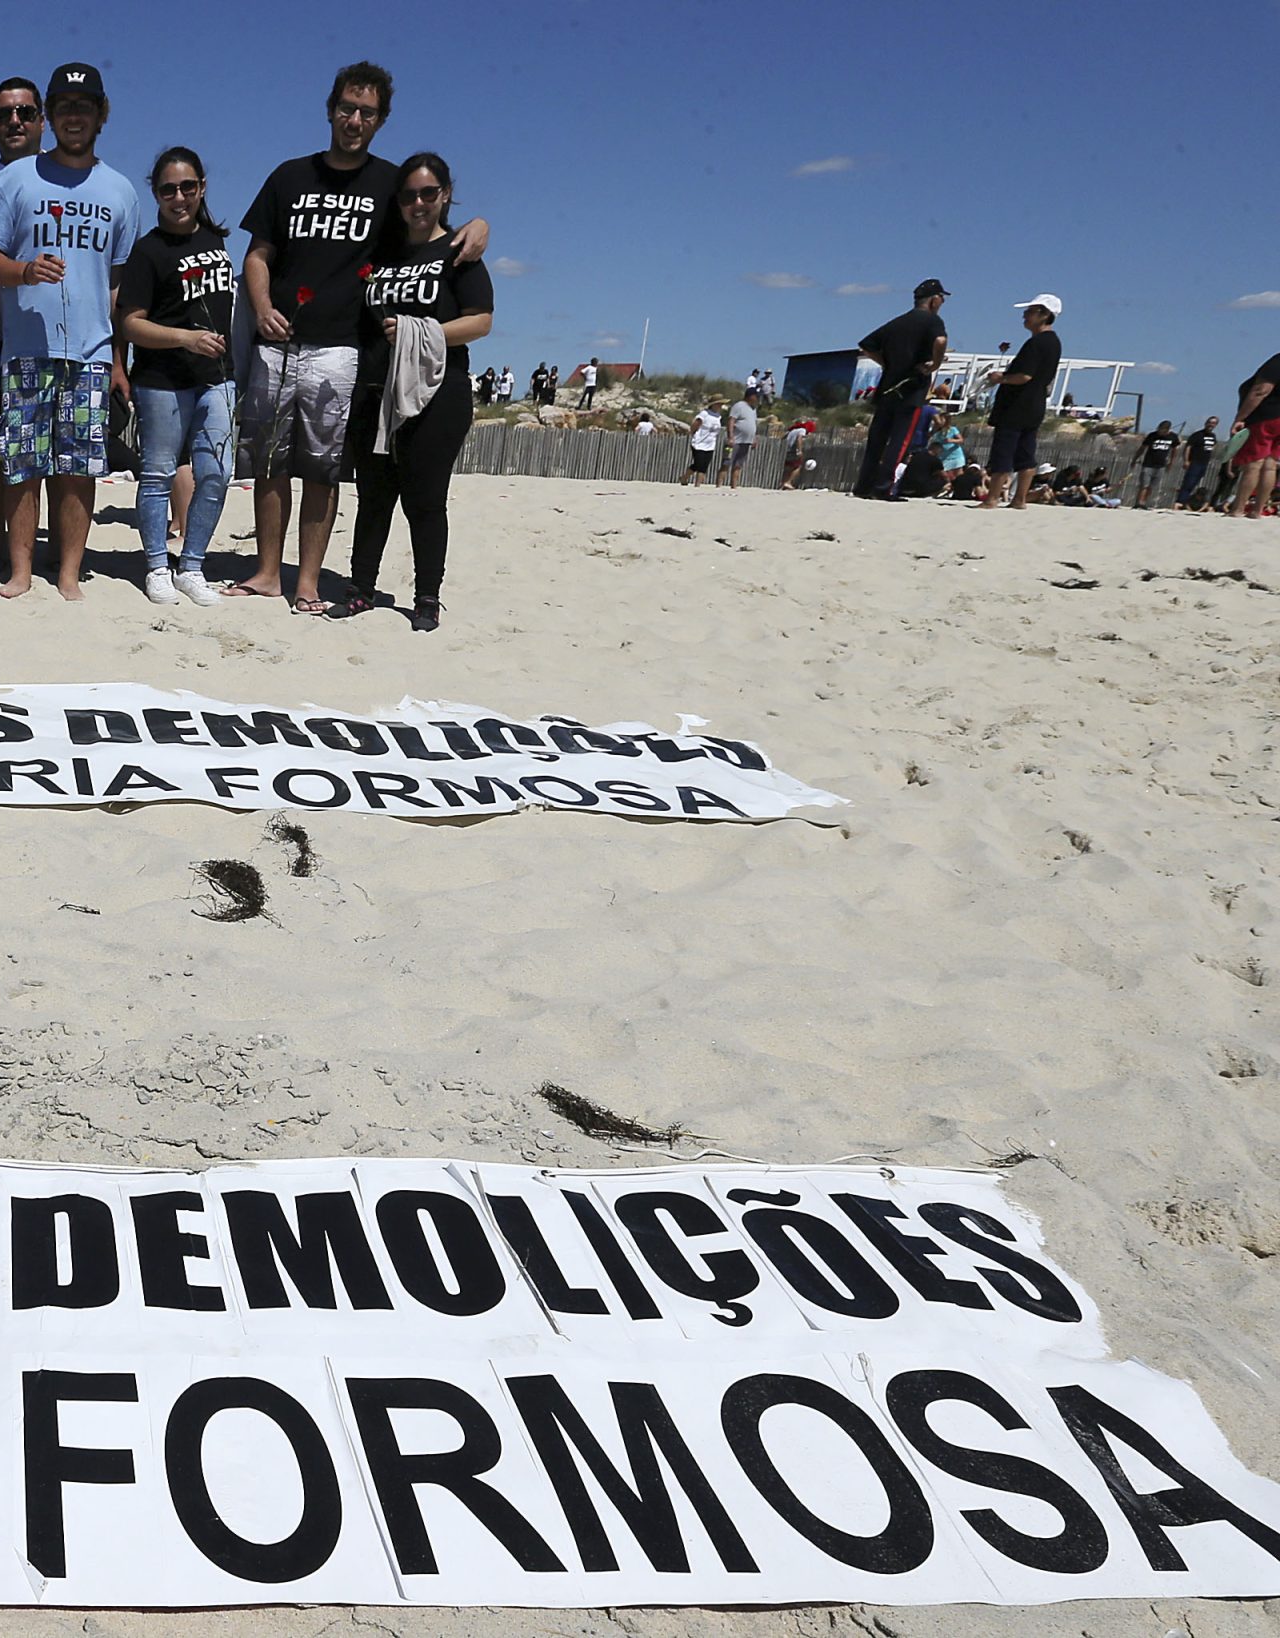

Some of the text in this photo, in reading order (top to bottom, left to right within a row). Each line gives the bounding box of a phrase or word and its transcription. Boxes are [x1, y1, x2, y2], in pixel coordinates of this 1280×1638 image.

[64, 201, 112, 223] SUIS
[292, 193, 375, 213] JE SUIS
[33, 219, 110, 253] ILHÉU
[289, 211, 372, 242] ILHÉU
[177, 255, 200, 272] JE
[373, 260, 445, 278] JE SUIS
[366, 276, 439, 307] ILHÉU
[205, 766, 751, 818] FORMOSA
[10, 1188, 1083, 1328] DEMOLIÇÕES
[21, 1368, 1280, 1584] FORMOSA
